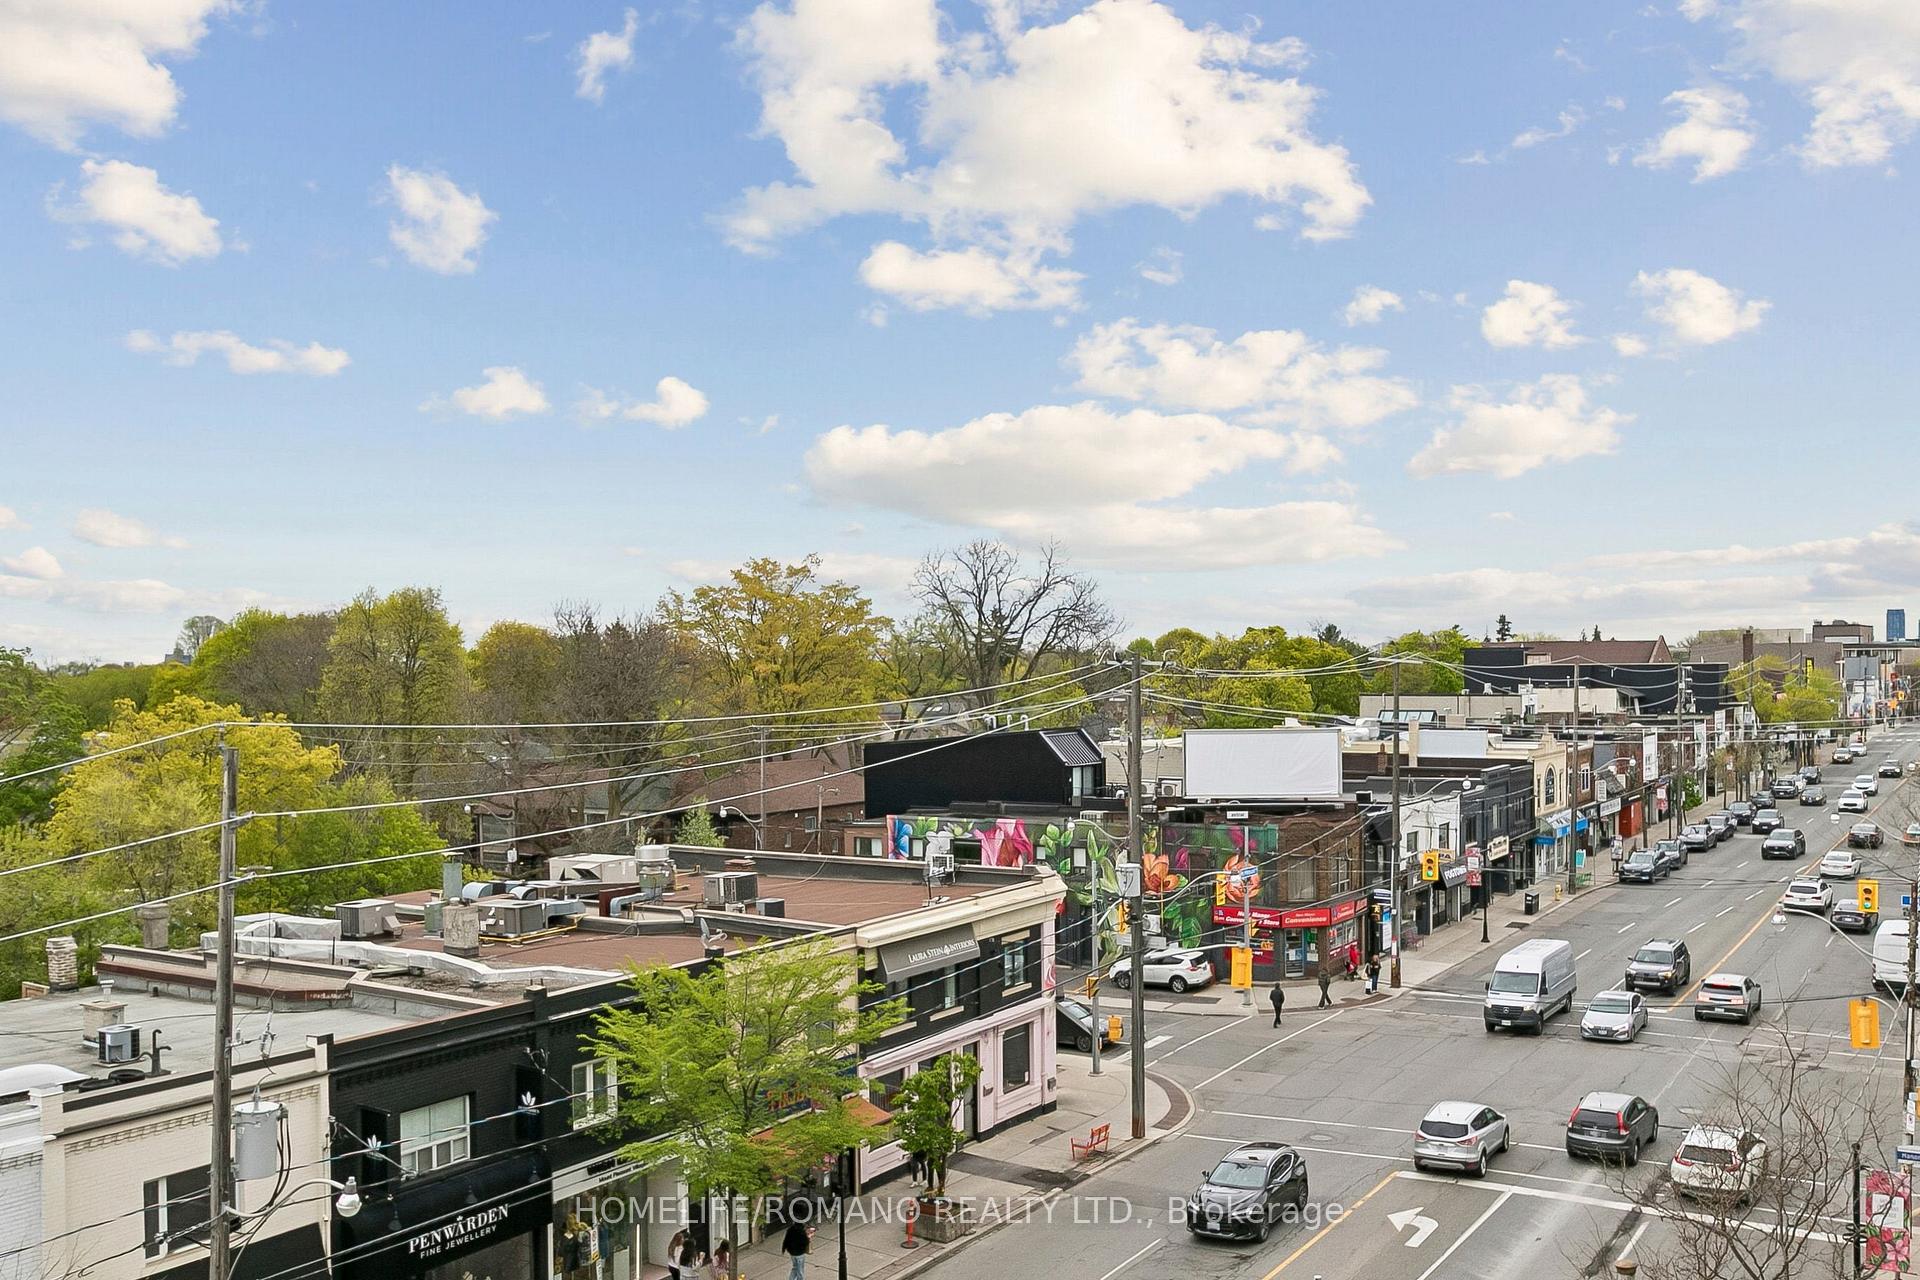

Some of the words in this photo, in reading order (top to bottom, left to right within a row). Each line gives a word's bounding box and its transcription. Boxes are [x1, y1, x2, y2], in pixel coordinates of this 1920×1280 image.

[408, 1203, 510, 1254] PENWARDEN
[420, 1245, 442, 1259] FINE
[445, 1225, 497, 1250] JEWELLERY
